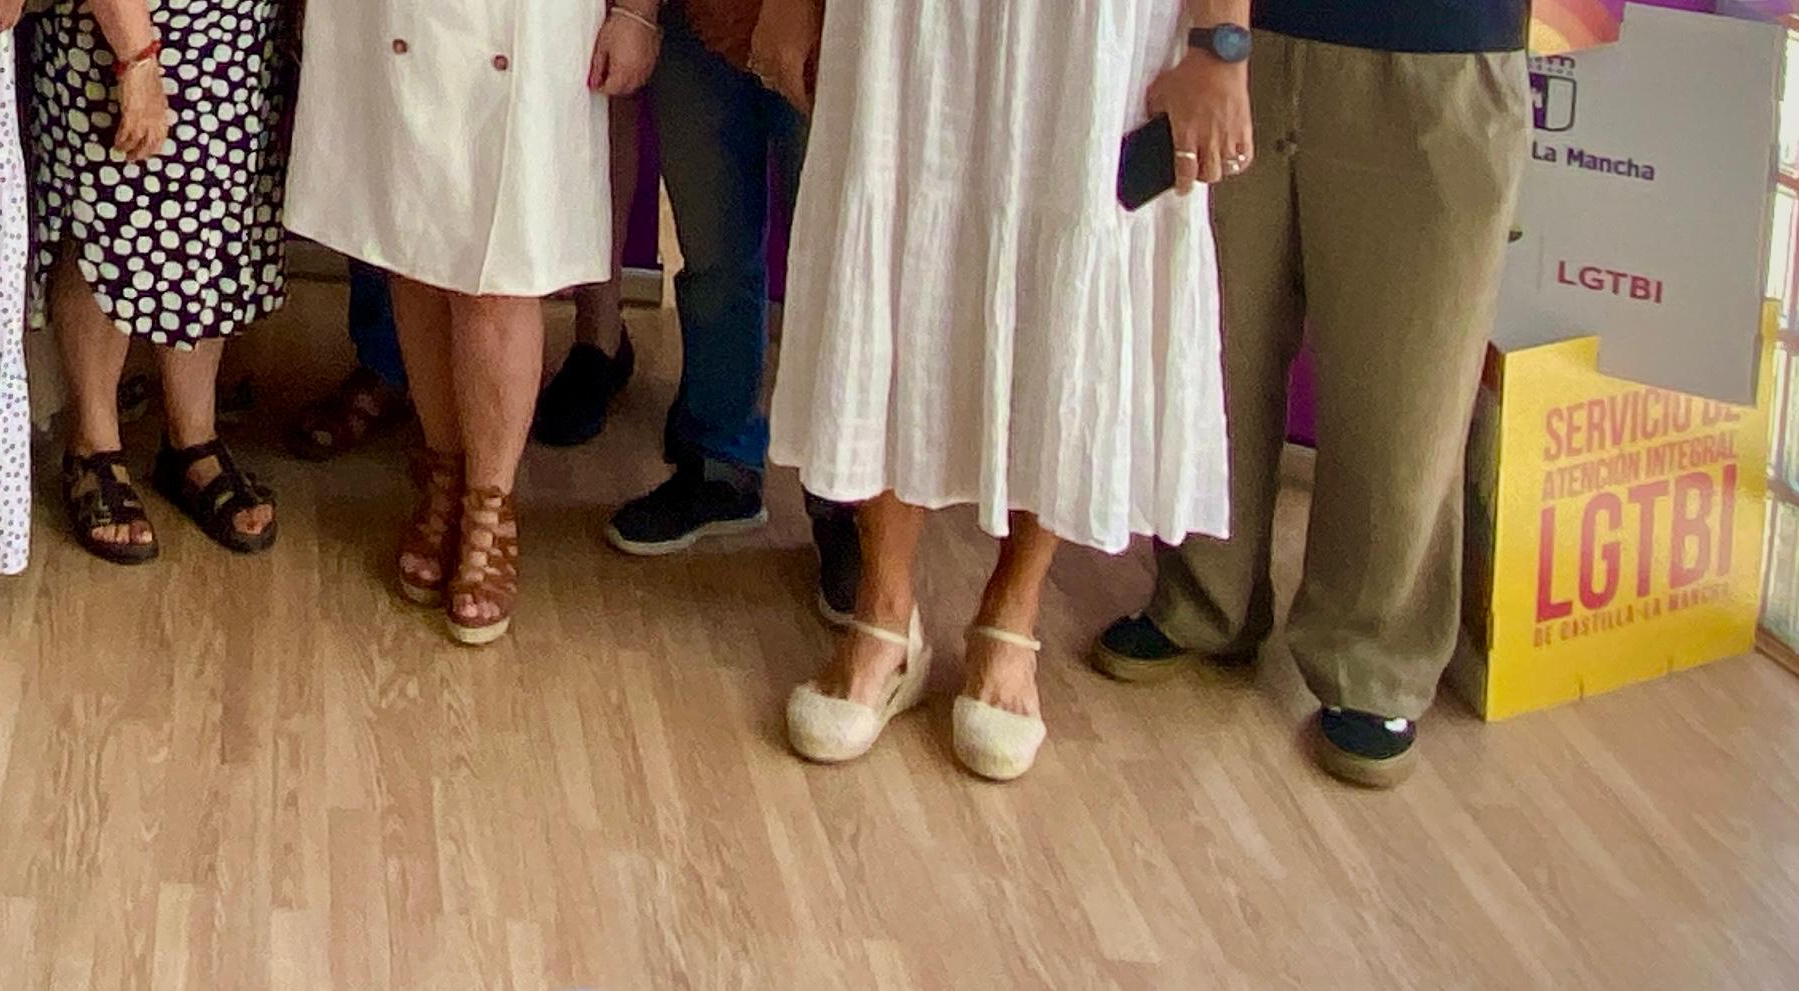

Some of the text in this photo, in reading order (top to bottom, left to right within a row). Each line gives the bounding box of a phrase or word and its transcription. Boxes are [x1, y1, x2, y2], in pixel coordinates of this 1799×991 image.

[1566, 147, 1655, 181] Mancha
[1557, 259, 1663, 304] LGTBI
[1543, 388, 1692, 462] SERVICIO
[1542, 431, 1738, 502] ATENCIÓN INTEGRAL
[1536, 463, 1738, 623] LGTBI
